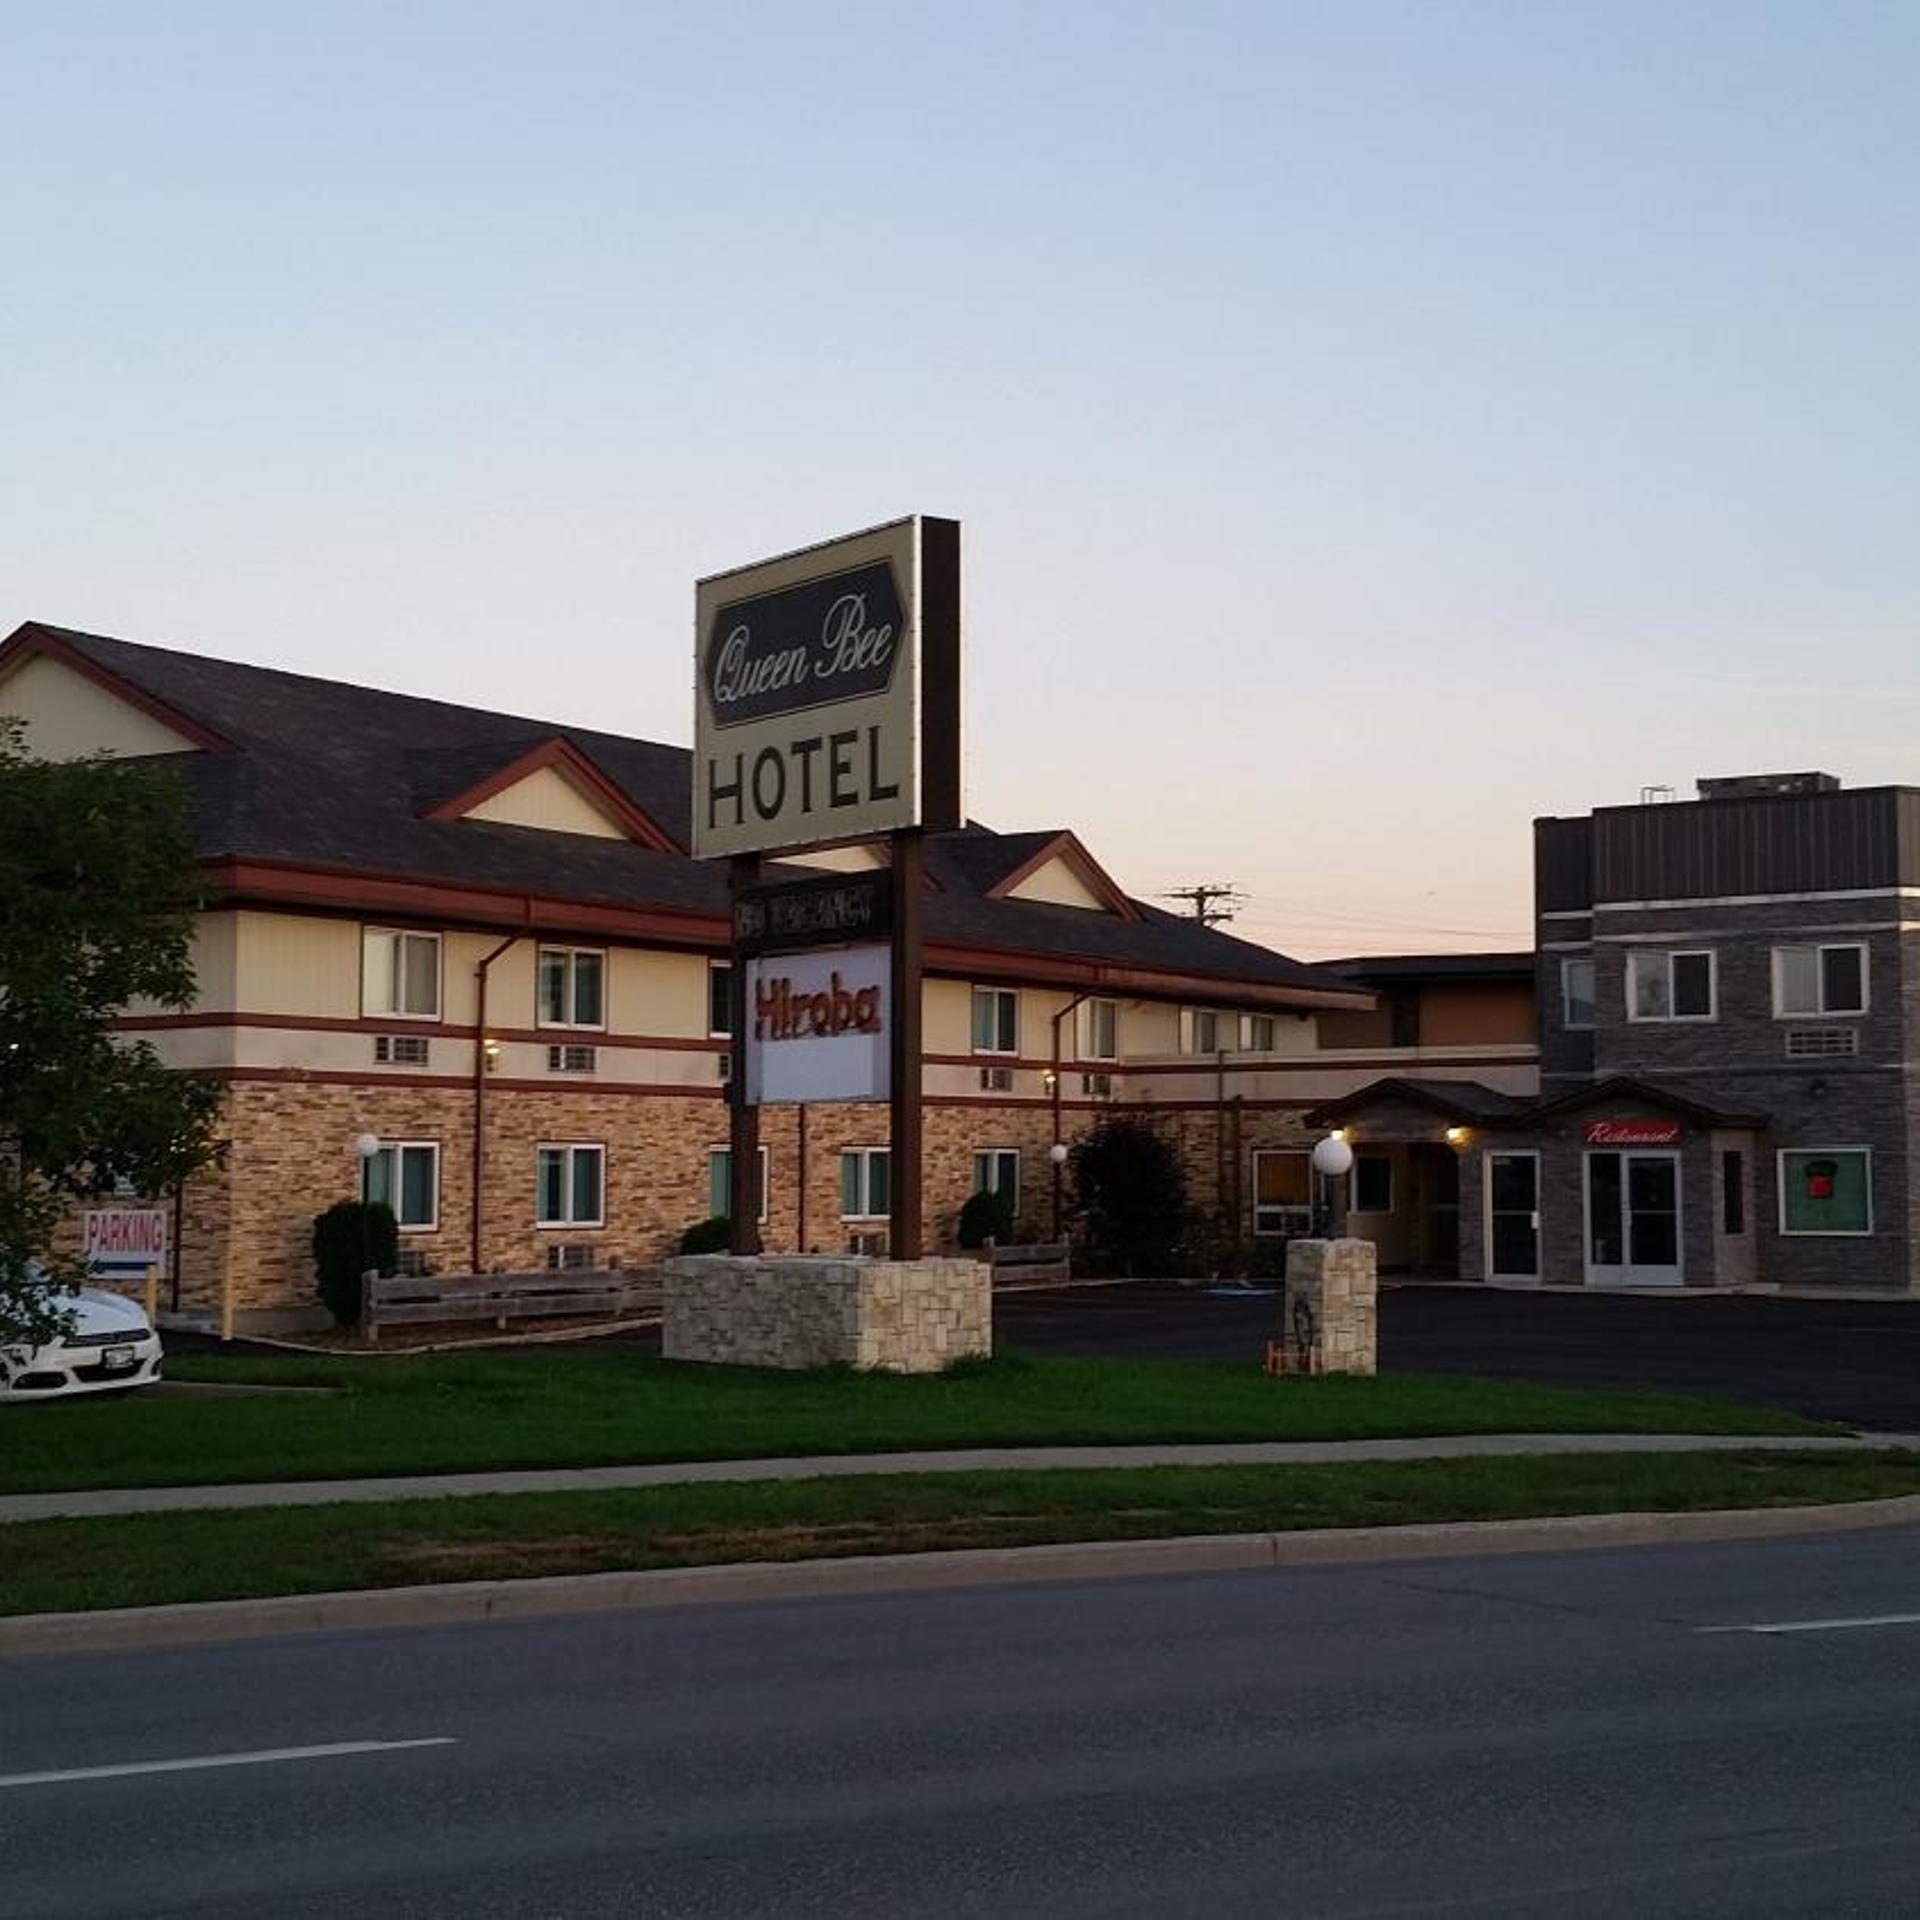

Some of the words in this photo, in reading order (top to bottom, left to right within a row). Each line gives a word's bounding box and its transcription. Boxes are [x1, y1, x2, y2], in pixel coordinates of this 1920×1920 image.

[714, 623, 808, 703] Queen
[813, 593, 893, 678] Bee
[708, 724, 899, 829] HOTEL
[1585, 1121, 1678, 1143] Restaurant
[88, 1213, 164, 1250] PARKING
